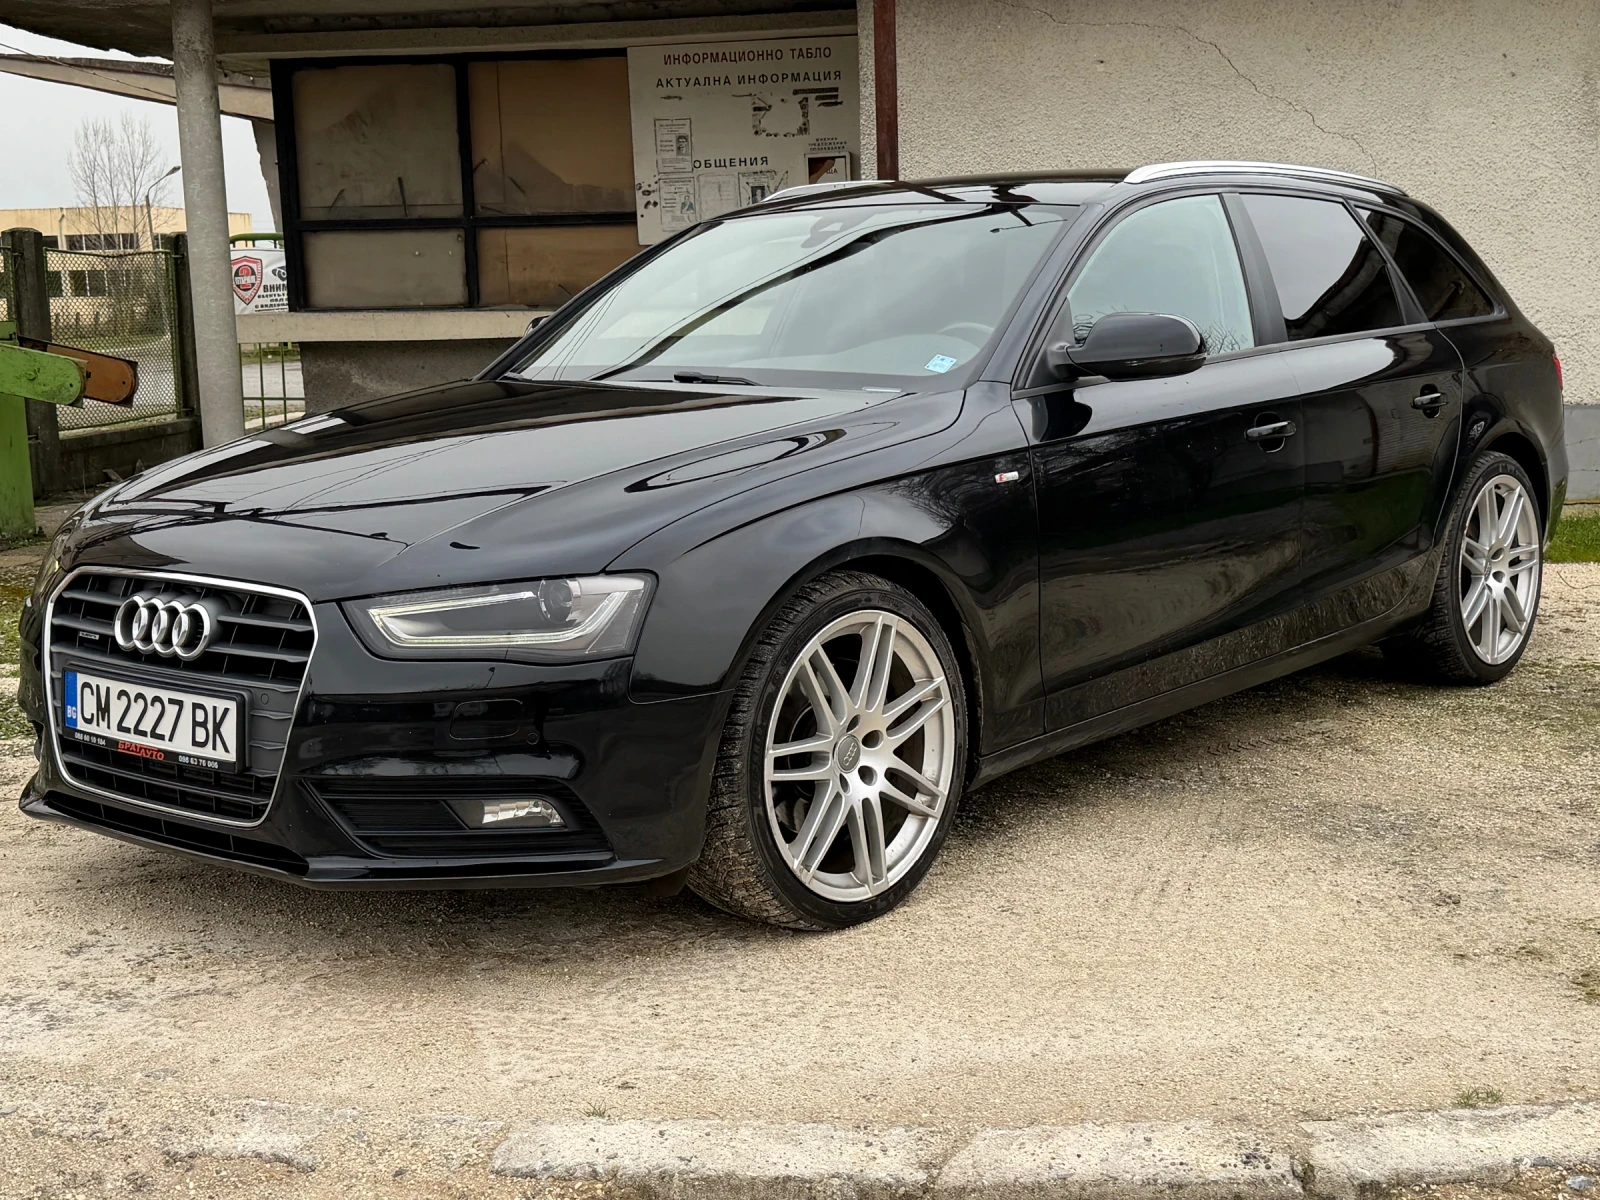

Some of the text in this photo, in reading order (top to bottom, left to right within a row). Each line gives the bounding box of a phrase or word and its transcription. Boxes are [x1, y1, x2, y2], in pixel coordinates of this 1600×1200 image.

[663, 46, 832, 65] ИНФОРМАЦИОННО ТАБЛО
[656, 70, 842, 88] АКТУАЛНА ИНФОРМАЦИЯ
[67, 705, 77, 719] BG
[80, 681, 231, 754] CM 2227 BK
